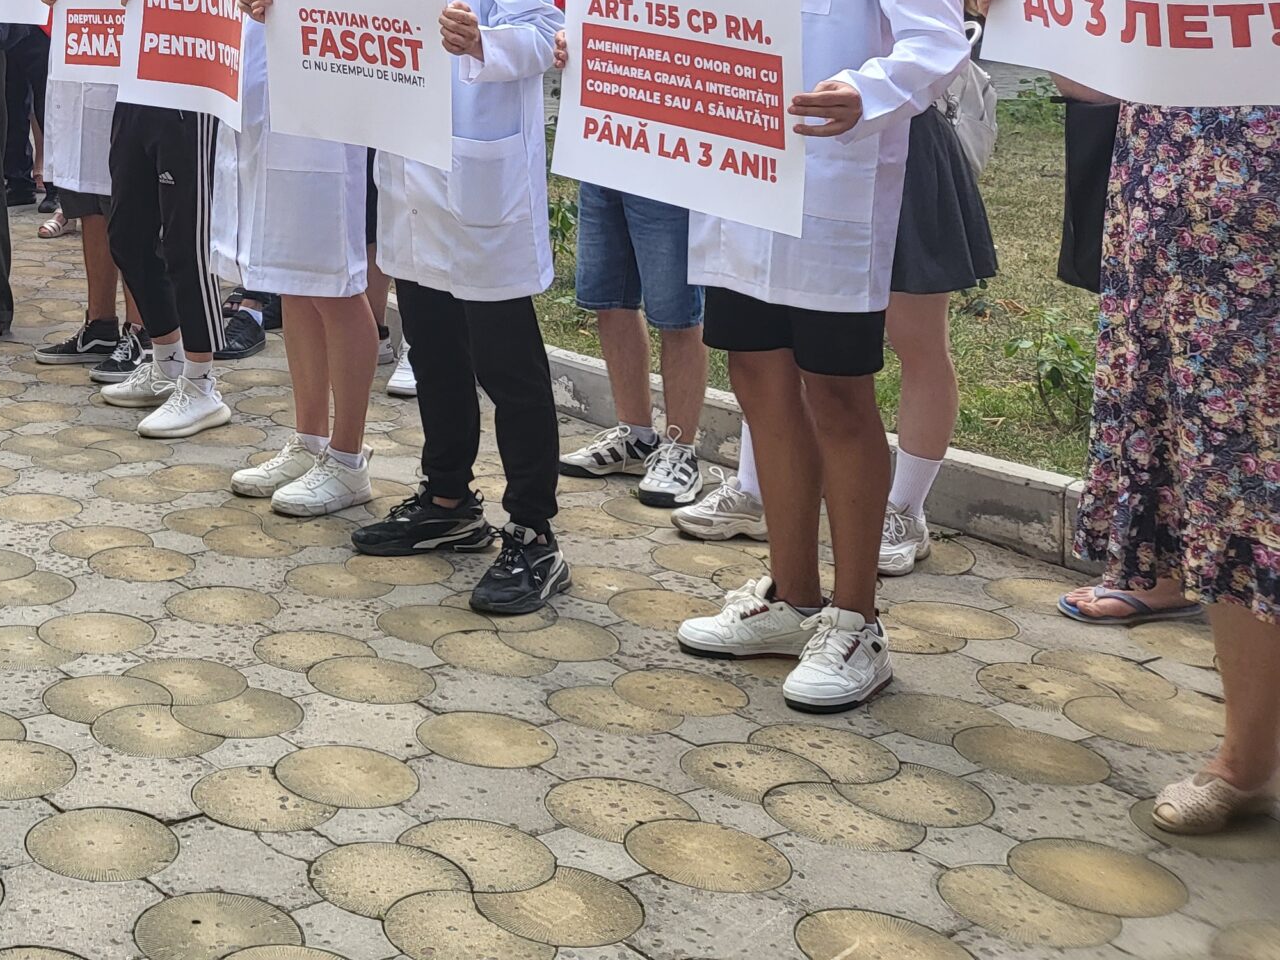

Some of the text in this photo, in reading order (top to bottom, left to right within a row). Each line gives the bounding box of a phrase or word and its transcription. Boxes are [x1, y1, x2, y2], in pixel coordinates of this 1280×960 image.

[67, 13, 103, 25] DREPTUL
[103, 14, 114, 25] LA
[298, 7, 369, 30] OCTAVIAN
[371, 16, 413, 35] GOGA
[645, 1, 681, 29] 155
[686, 8, 718, 34] CP
[724, 14, 772, 46] RM.
[1120, 0, 1280, 49] ЛЕТ!
[143, 32, 216, 61] PENTRU
[300, 25, 424, 72] FASCIST
[586, 38, 778, 84] AMENINȚAREA CU OMOR ORI CU
[301, 60, 425, 88] CI NU EXEMPLU DE URMAT!
[586, 58, 779, 109] VĂTĂMAREA GRAVĂ A INTEGRITĂȚII
[586, 78, 780, 132] CORPORALE SAU A SĂNĂTĂȚII
[583, 114, 777, 184] PÂNĂ LA 3 ANI!
